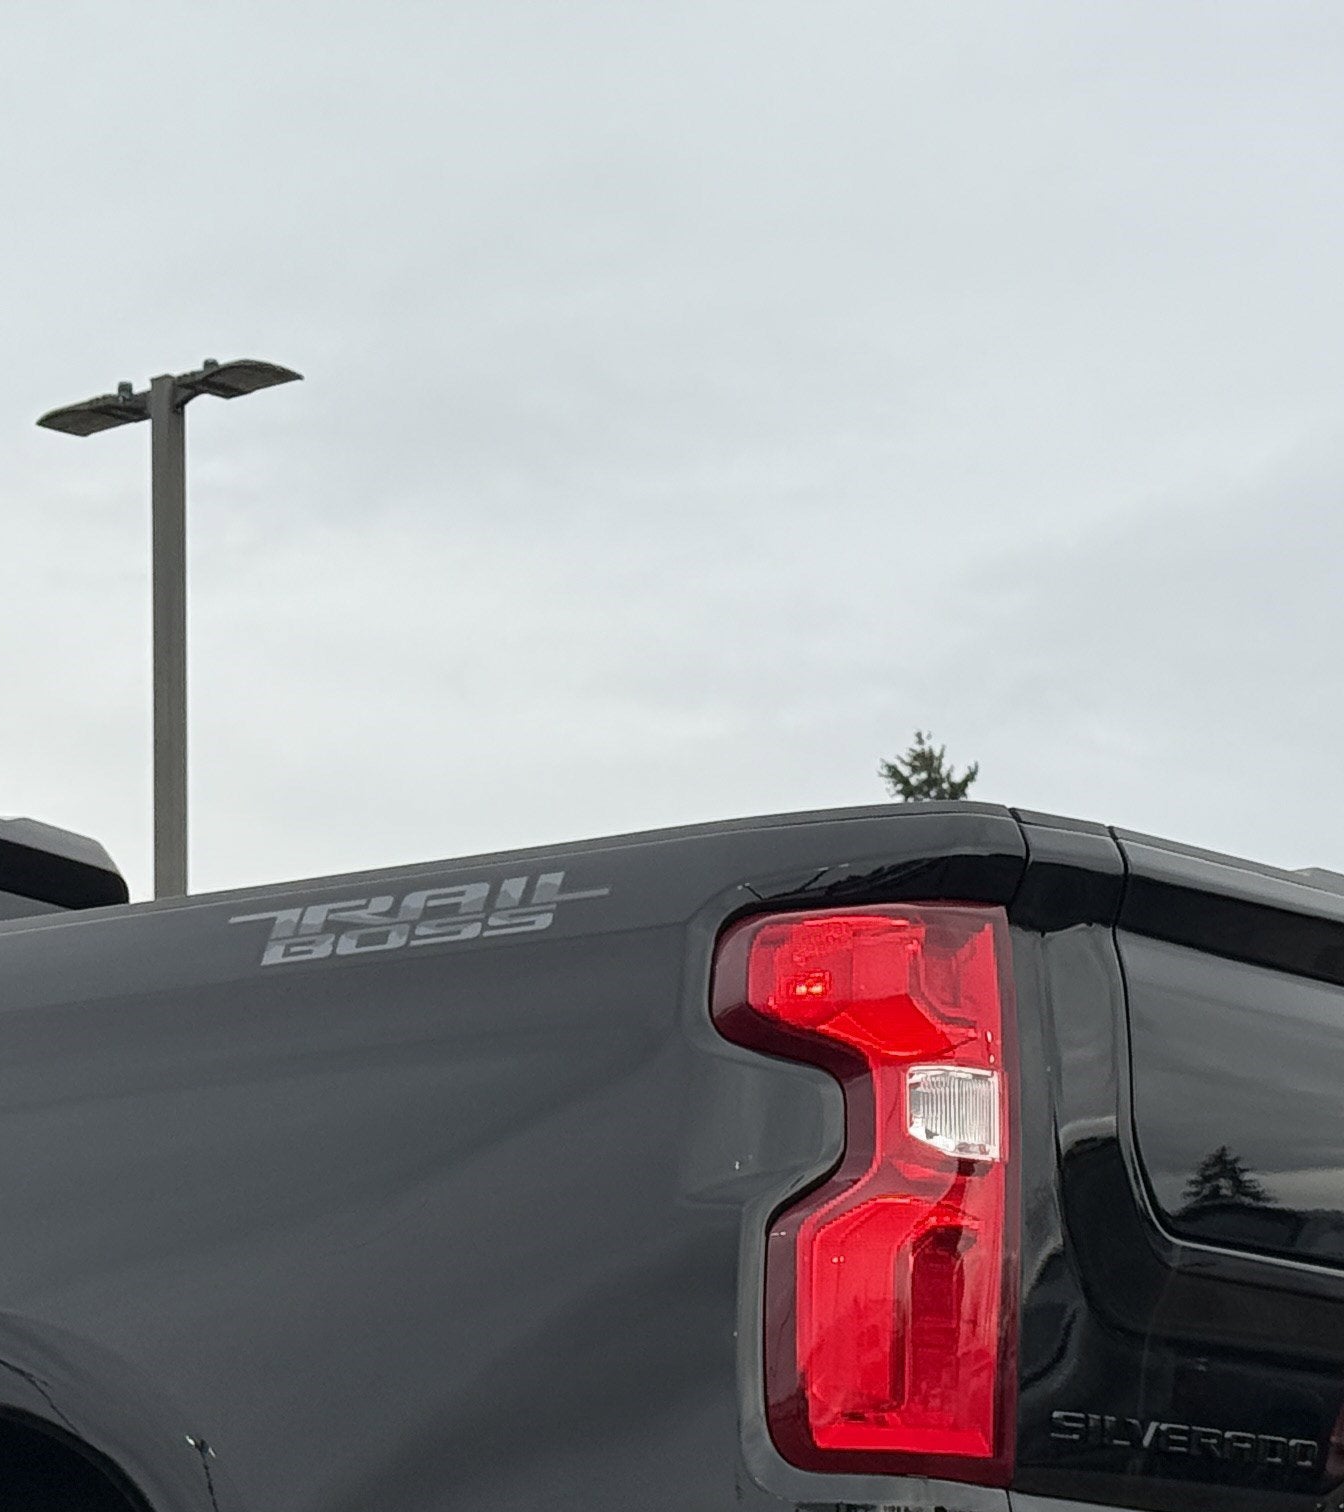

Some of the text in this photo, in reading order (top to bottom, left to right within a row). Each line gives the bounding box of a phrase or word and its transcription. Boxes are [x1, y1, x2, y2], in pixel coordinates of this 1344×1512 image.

[228, 871, 610, 940] TRAIL
[260, 904, 558, 967] BOSS
[1050, 1409, 1319, 1468] SILVERADO
